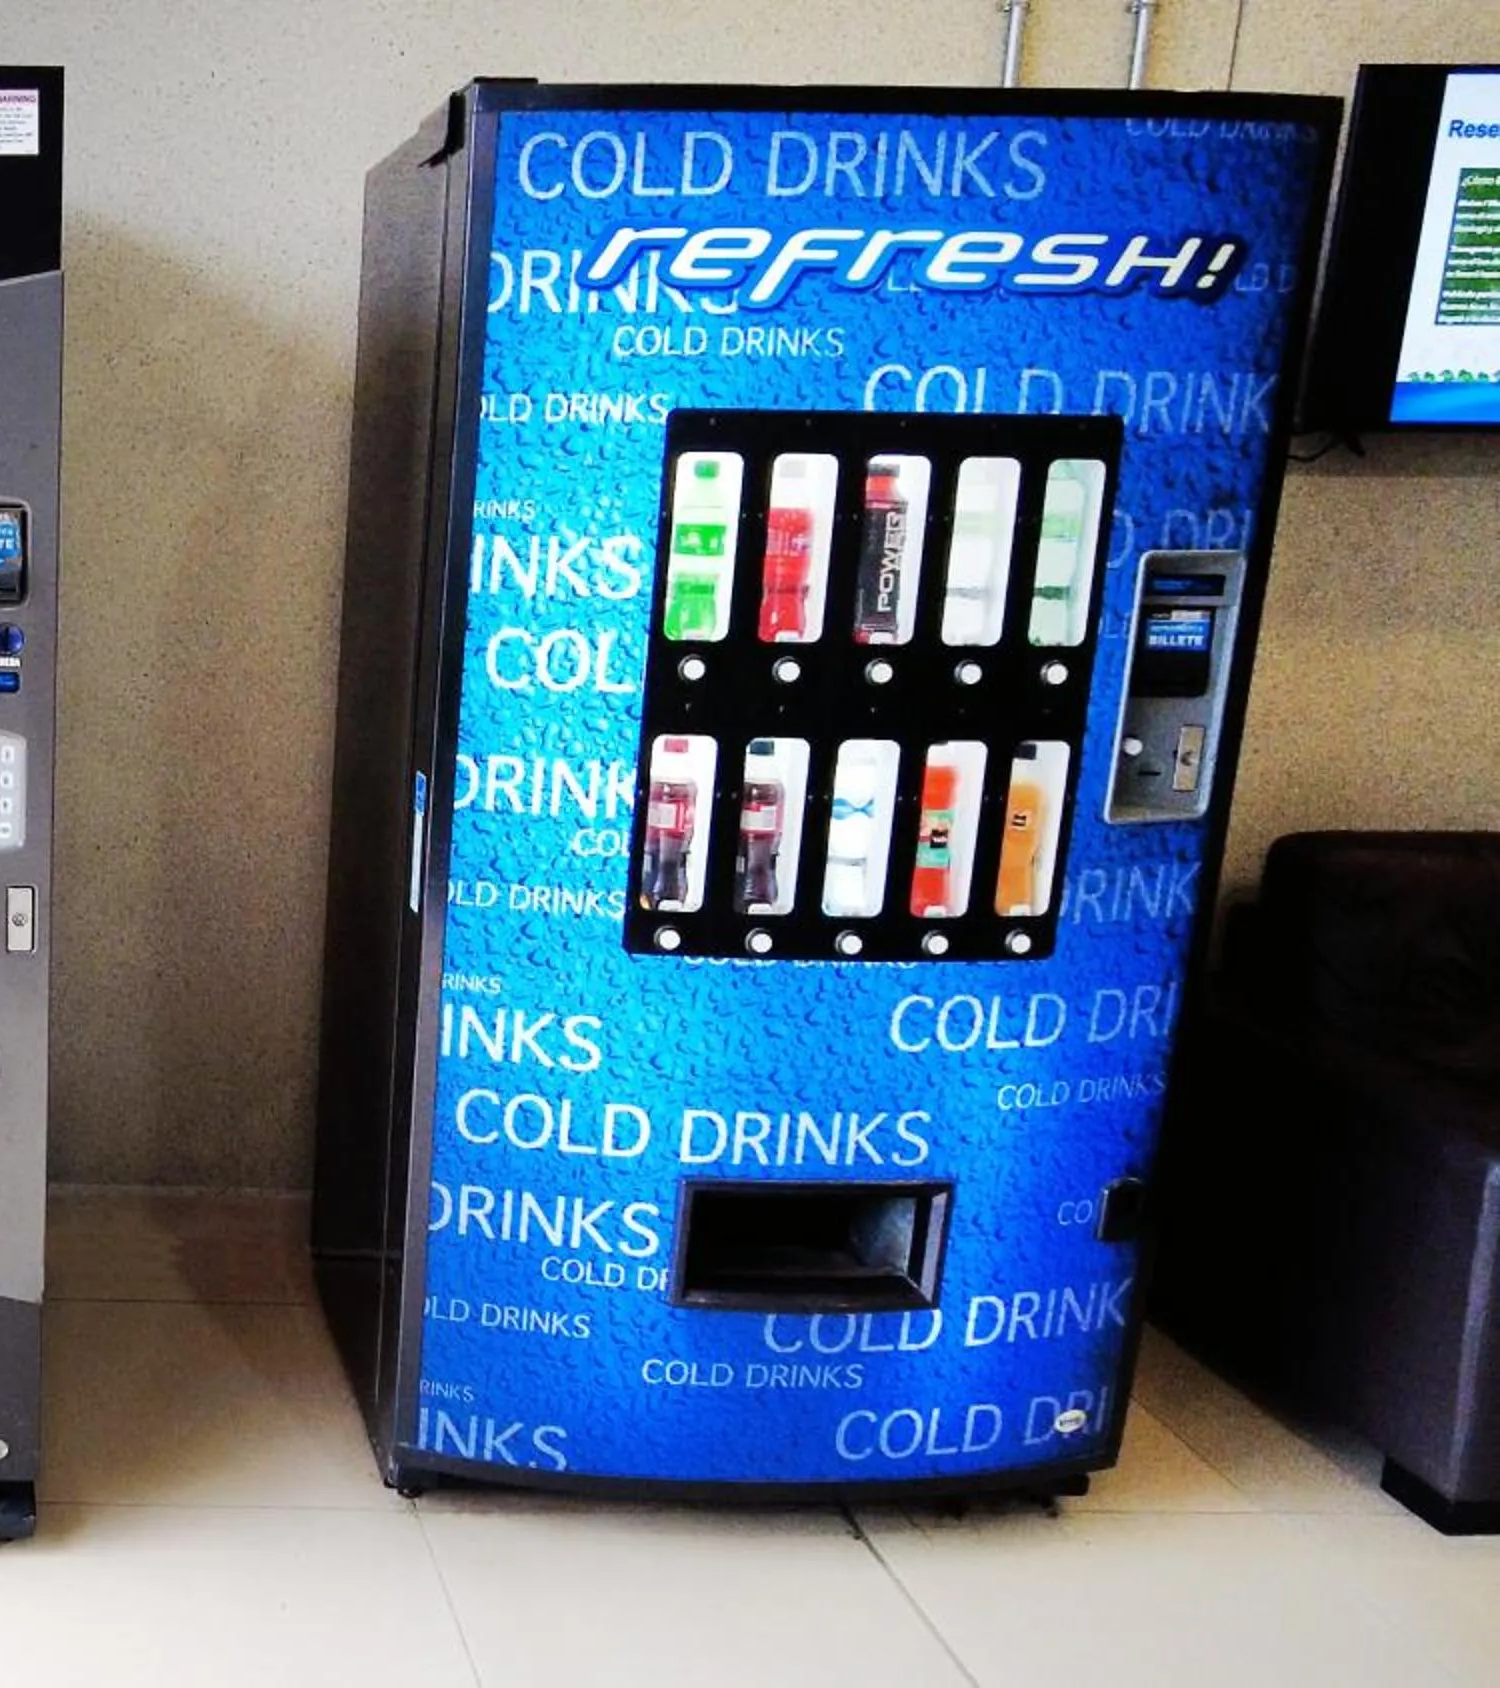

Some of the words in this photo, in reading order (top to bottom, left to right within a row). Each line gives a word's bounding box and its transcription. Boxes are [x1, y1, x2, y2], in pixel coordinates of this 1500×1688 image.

[518, 131, 734, 201] COLD
[766, 129, 1049, 200] DRINKS
[613, 324, 708, 358] COLD
[720, 326, 845, 358] DRINKS
[544, 393, 669, 425] DRINKS
[471, 535, 642, 600] INKS
[486, 626, 649, 693] COL
[509, 884, 627, 920] DRINKS
[1060, 861, 1202, 925] RINK
[440, 1003, 603, 1073] INKS
[889, 993, 1068, 1053] COLD
[997, 1080, 1071, 1111] COLD
[1078, 1071, 1167, 1103] DRINKS
[455, 1088, 651, 1158] COLD
[678, 1108, 933, 1167] DRINKS
[540, 1255, 626, 1289] COLD
[480, 1302, 591, 1340] DRINKS
[763, 1308, 943, 1354] COLD
[641, 1359, 735, 1387] COLD
[745, 1363, 865, 1389] DRINKS
[835, 1404, 1003, 1462] COLD
